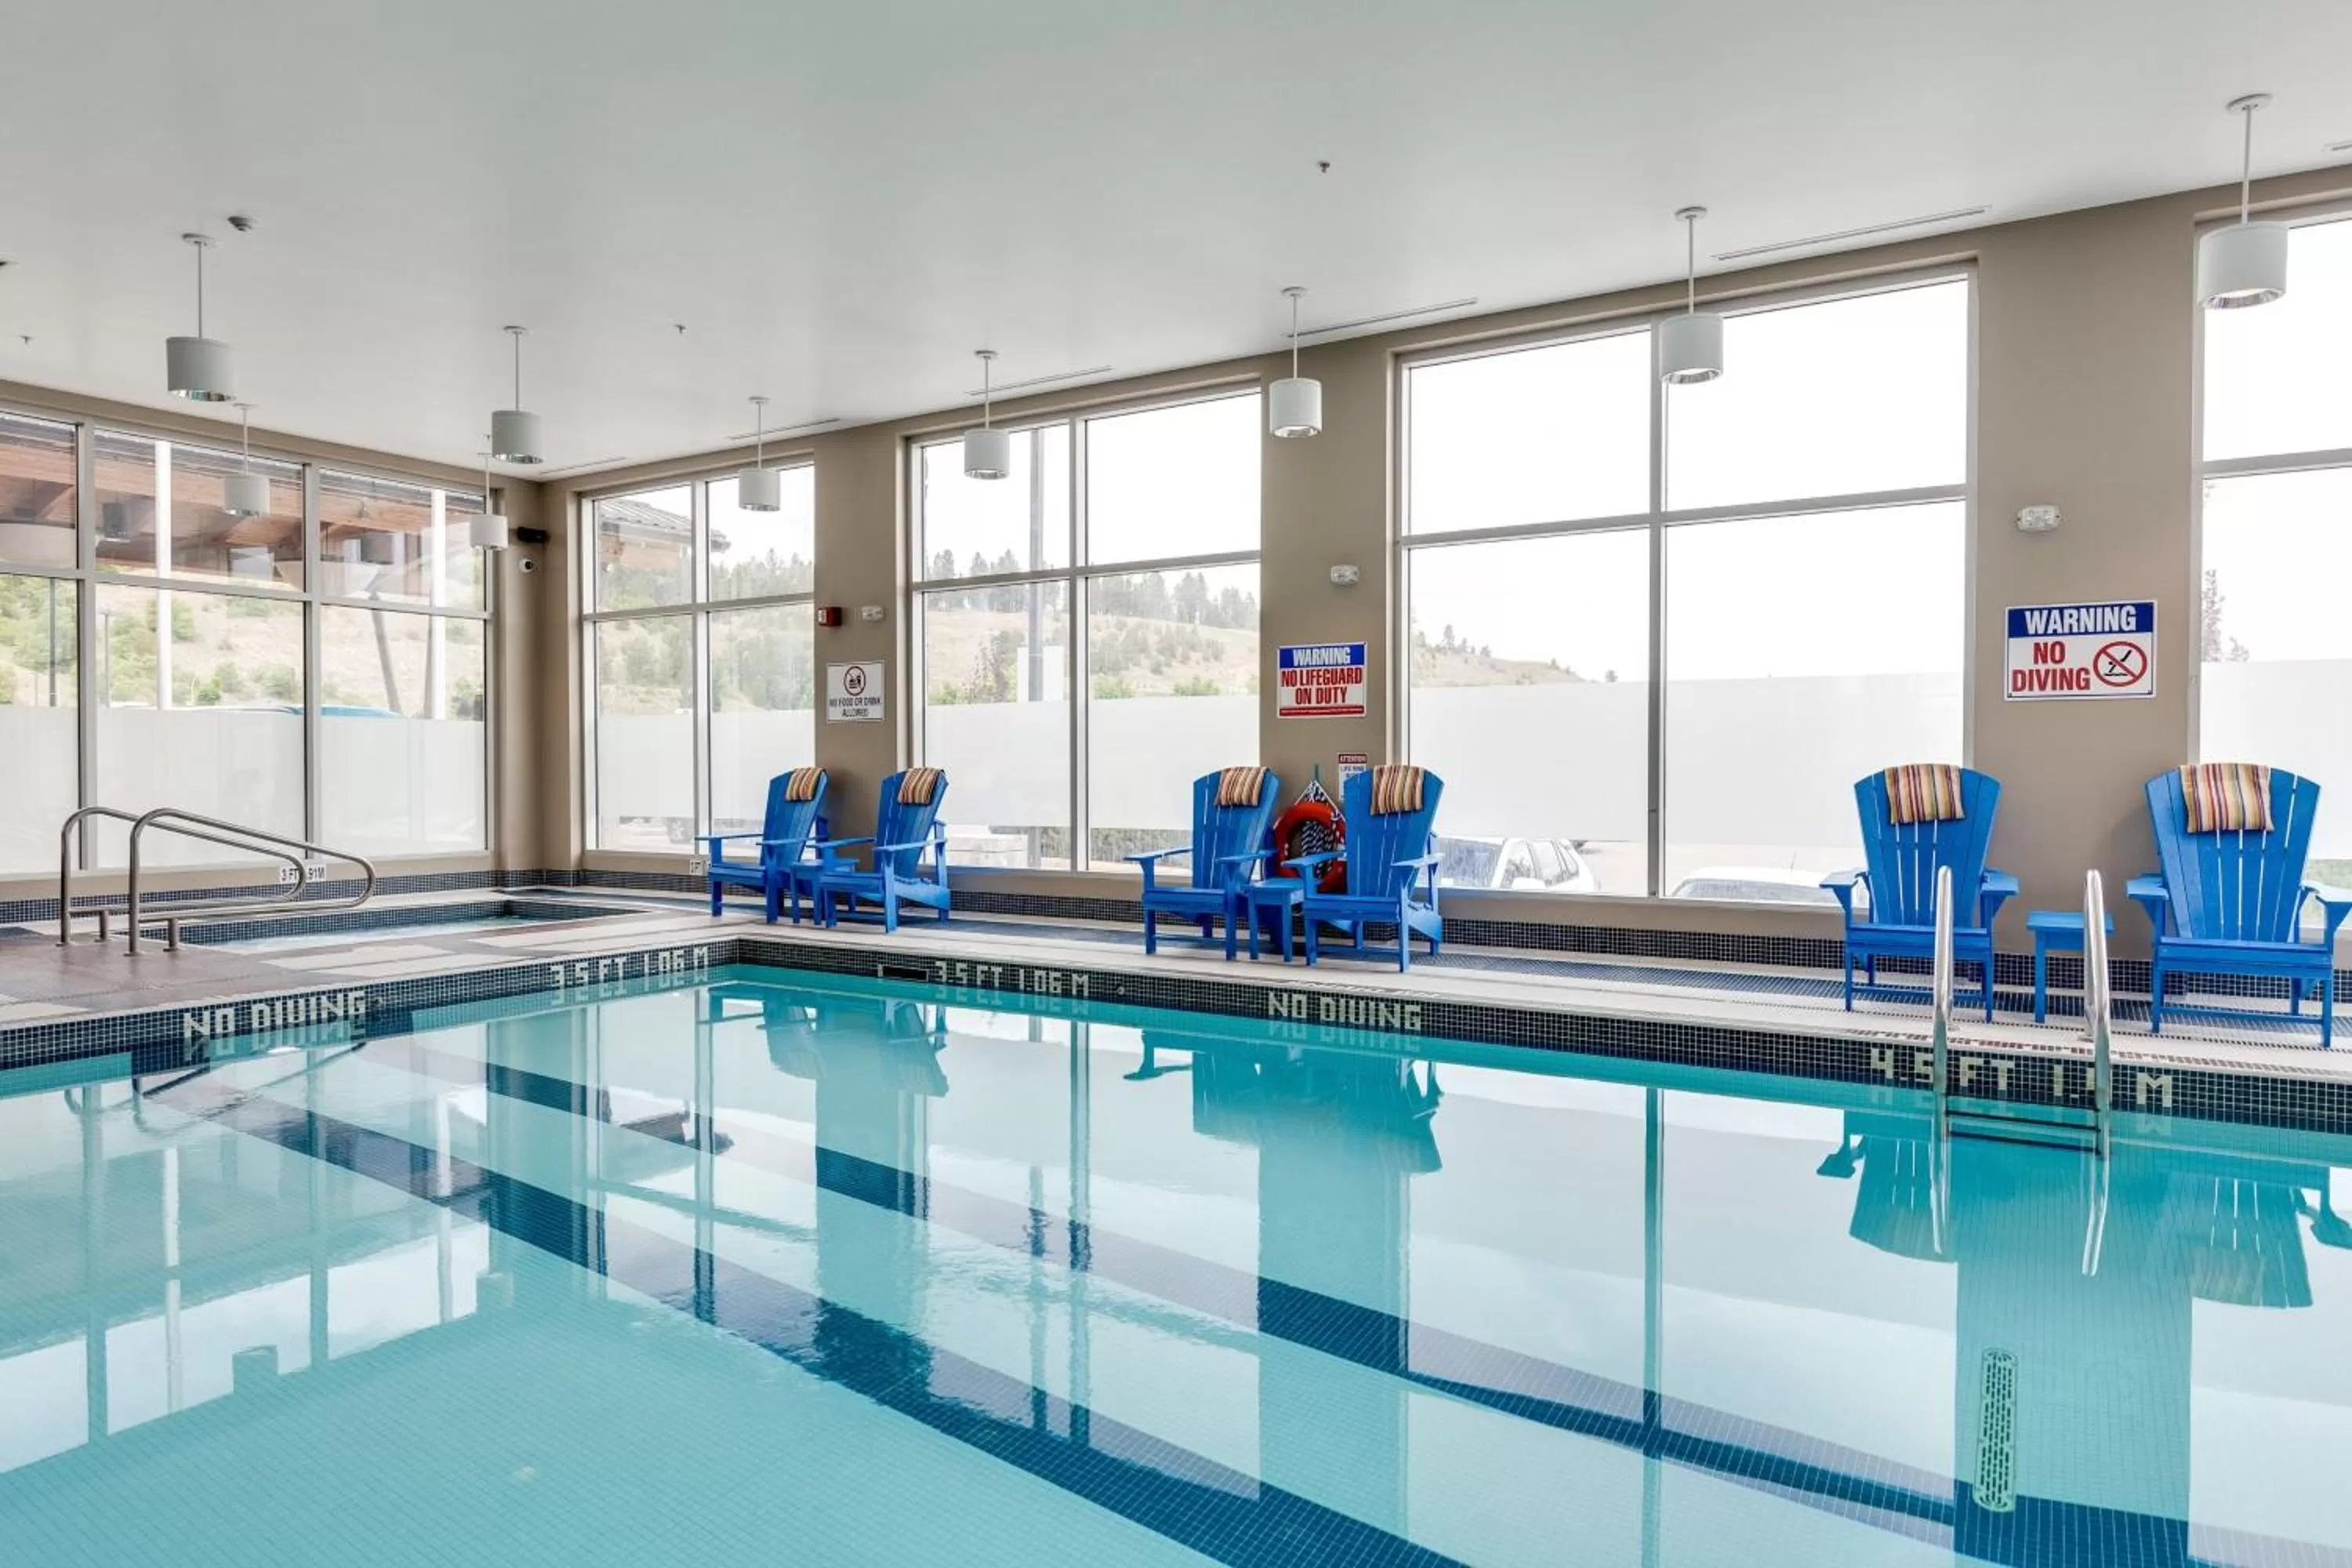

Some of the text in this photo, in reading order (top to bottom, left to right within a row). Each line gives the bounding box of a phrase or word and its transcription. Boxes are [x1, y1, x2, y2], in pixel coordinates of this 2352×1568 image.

[2024, 604, 2137, 635] WARNING
[1293, 647, 1351, 666] WARNING
[2033, 641, 2066, 665] NO
[1281, 667, 1363, 688] NO LIFEGUARD
[2012, 667, 2091, 692] DIVING
[839, 697, 854, 707] FOOD
[855, 697, 863, 706] OR
[864, 697, 881, 706] DRINK
[1295, 687, 1348, 705] ON DUTY
[550, 946, 709, 988] 3.5 FT 1.06 M
[935, 960, 1090, 996] 3.5 FT 1.06 M
[183, 990, 366, 1038] NO DIVING
[1268, 992, 1421, 1031] NO DIVING
[1958, 1055, 2016, 1091] FT
[2136, 1072, 2173, 1108] M
